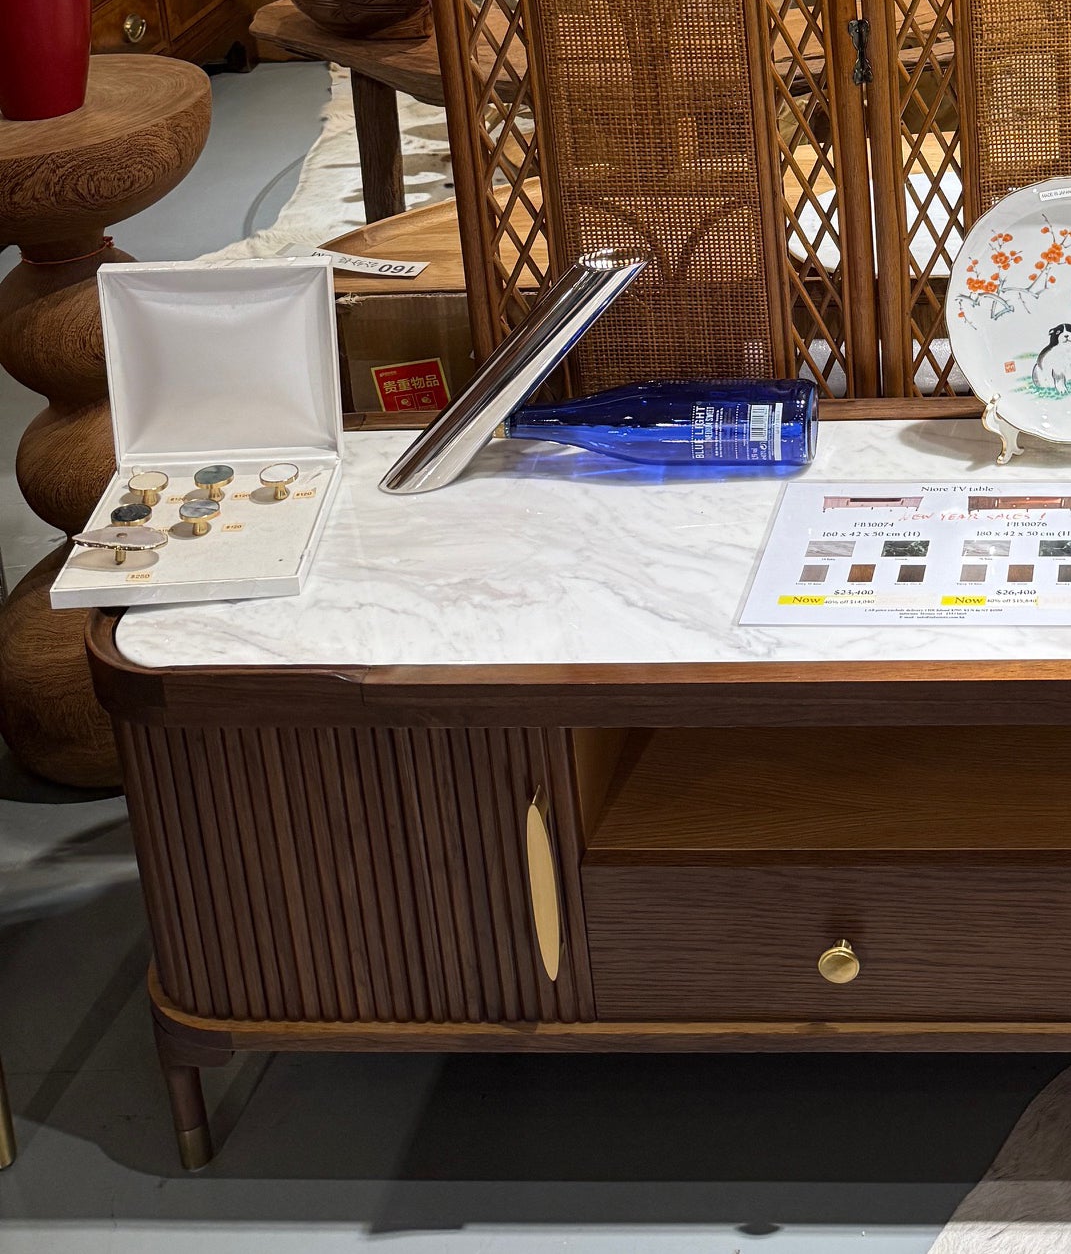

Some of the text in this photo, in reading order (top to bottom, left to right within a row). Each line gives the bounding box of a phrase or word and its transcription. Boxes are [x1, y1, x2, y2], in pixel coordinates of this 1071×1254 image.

[379, 264, 416, 275] 160
[383, 374, 440, 394] 贵重物品
[695, 406, 705, 459] BLUE LIGHT
[792, 596, 821, 604] Now
